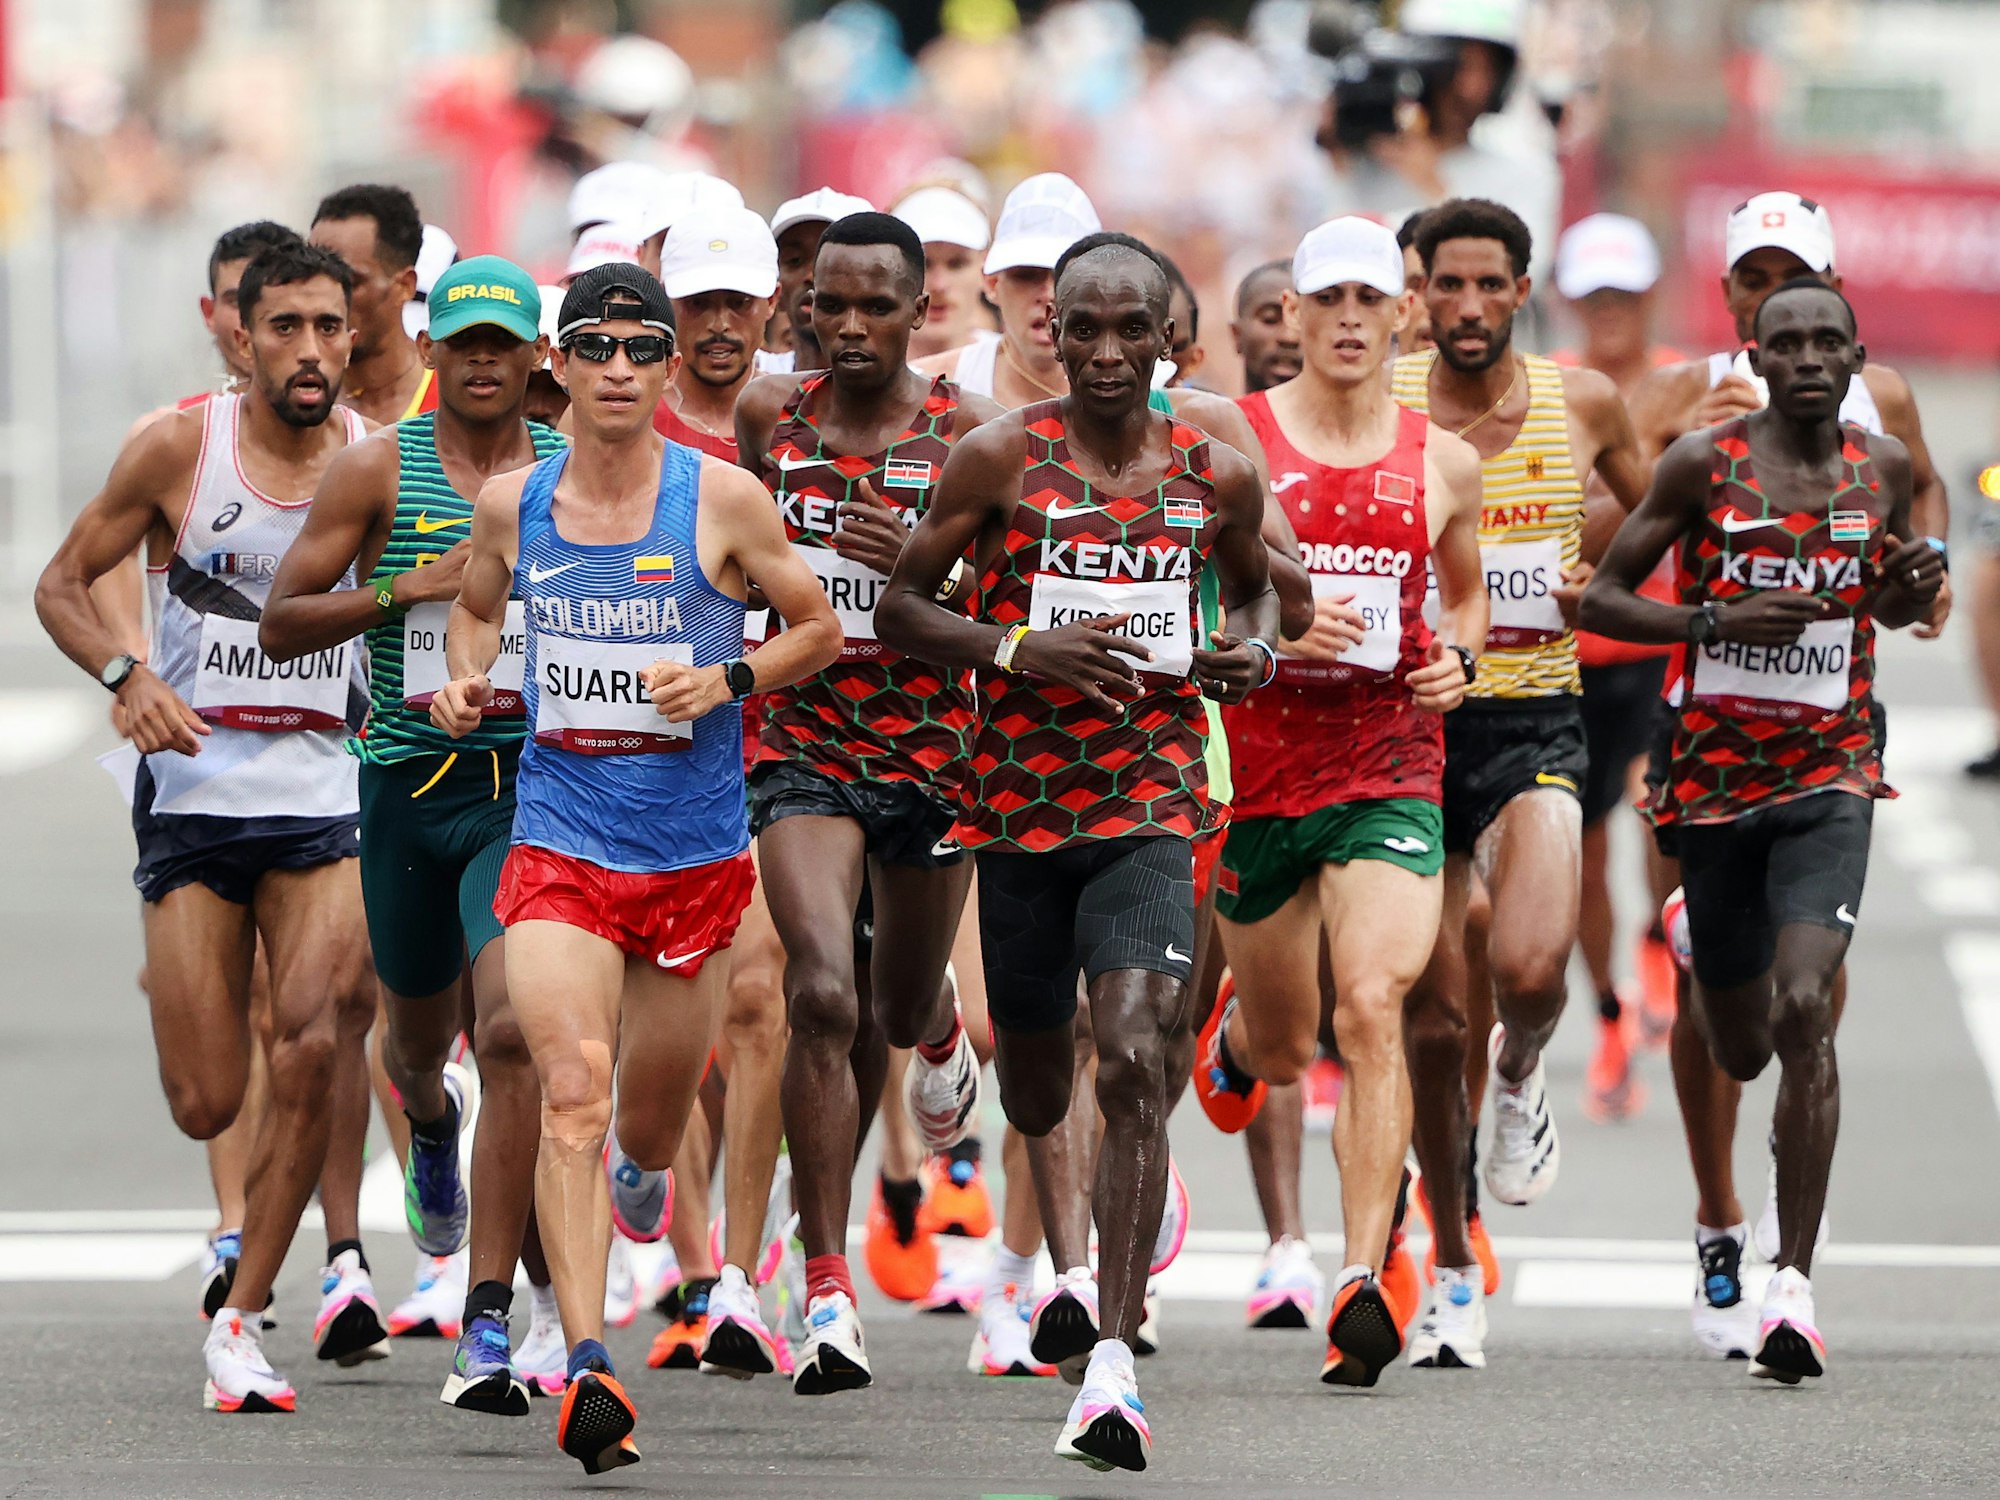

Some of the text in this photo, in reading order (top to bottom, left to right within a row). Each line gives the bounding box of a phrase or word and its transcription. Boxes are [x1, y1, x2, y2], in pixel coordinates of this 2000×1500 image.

[447, 284, 522, 305] BRASIL
[1039, 539, 1192, 579] KENYA
[1720, 550, 1863, 592] KENYA
[531, 596, 685, 637] COLOMBIA
[411, 630, 434, 651] DO
[574, 737, 617, 748] TOKYO 2020
